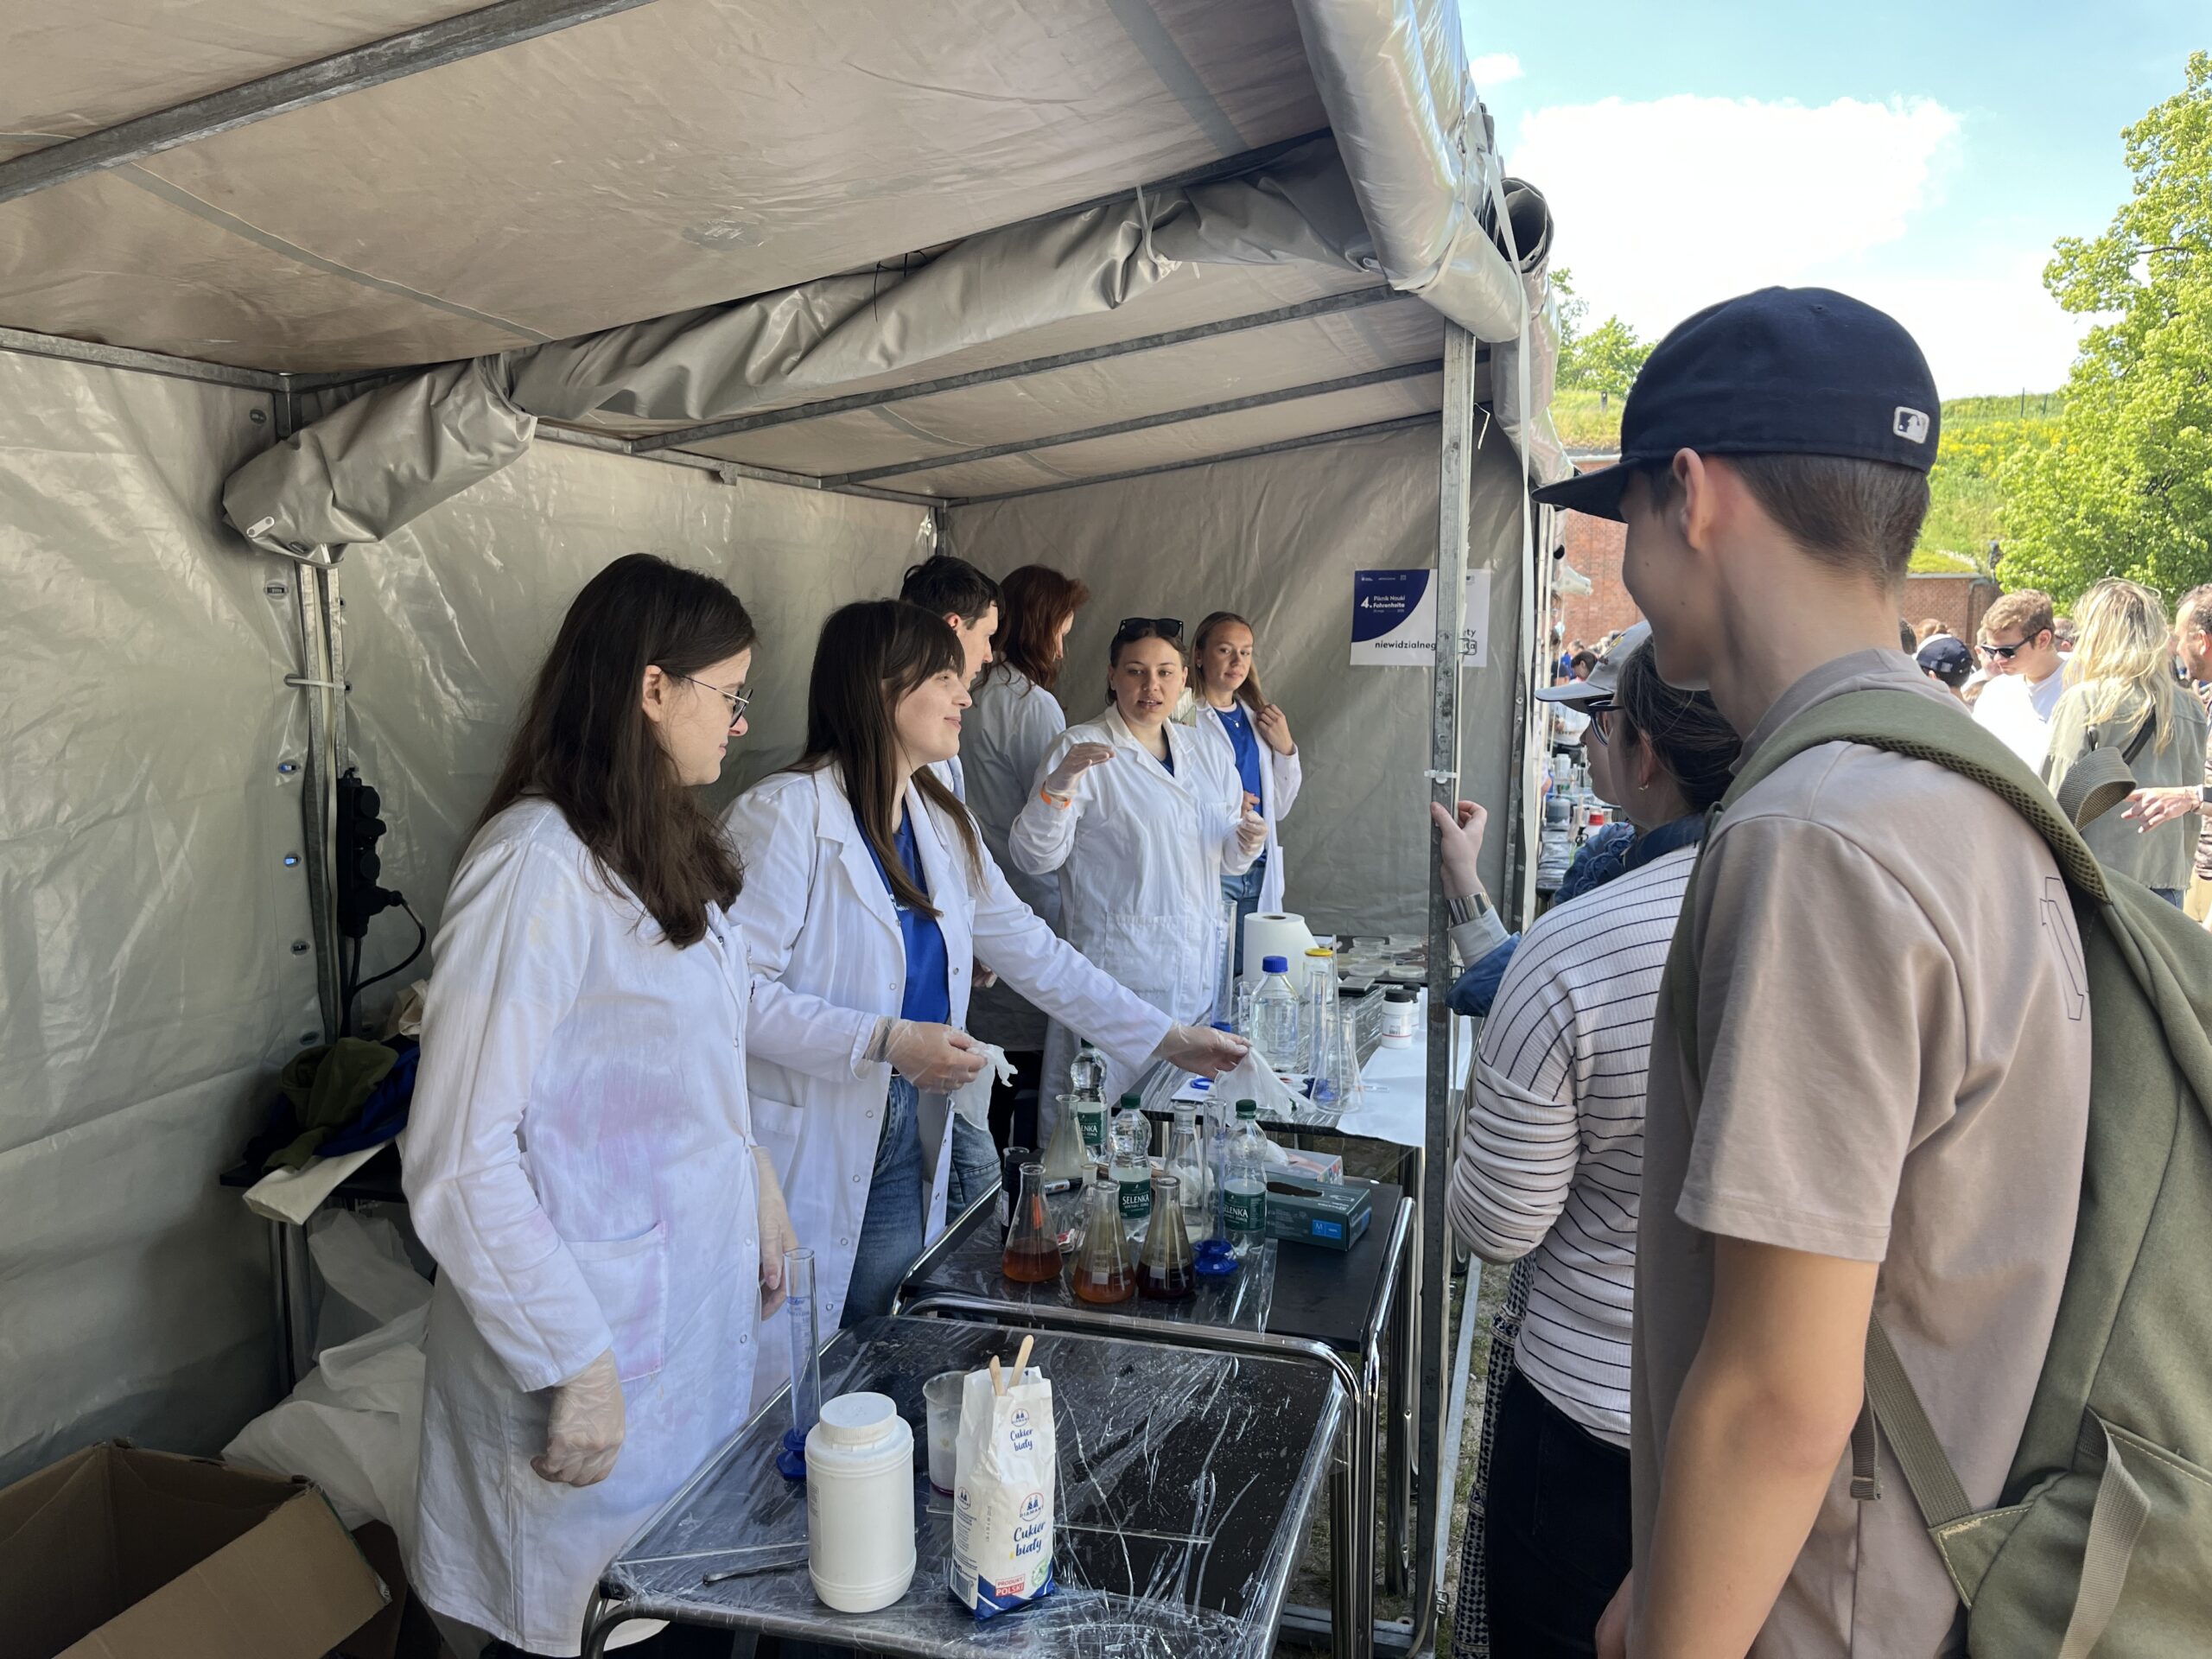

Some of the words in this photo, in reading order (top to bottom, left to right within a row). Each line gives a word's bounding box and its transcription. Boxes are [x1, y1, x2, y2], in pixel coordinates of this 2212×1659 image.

[1360, 596, 1373, 608] 4.
[1375, 640, 1437, 651] niewidzialneg
[1122, 1193, 1150, 1205] SELENKA
[1010, 1428, 1033, 1441] Cukier
[1014, 1439, 1033, 1452] biały
[1014, 1521, 1046, 1542] Cukier
[1015, 1538, 1042, 1557] biały
[997, 1577, 1024, 1586] PRODUKT
[995, 1583, 1025, 1597] POLSKI
